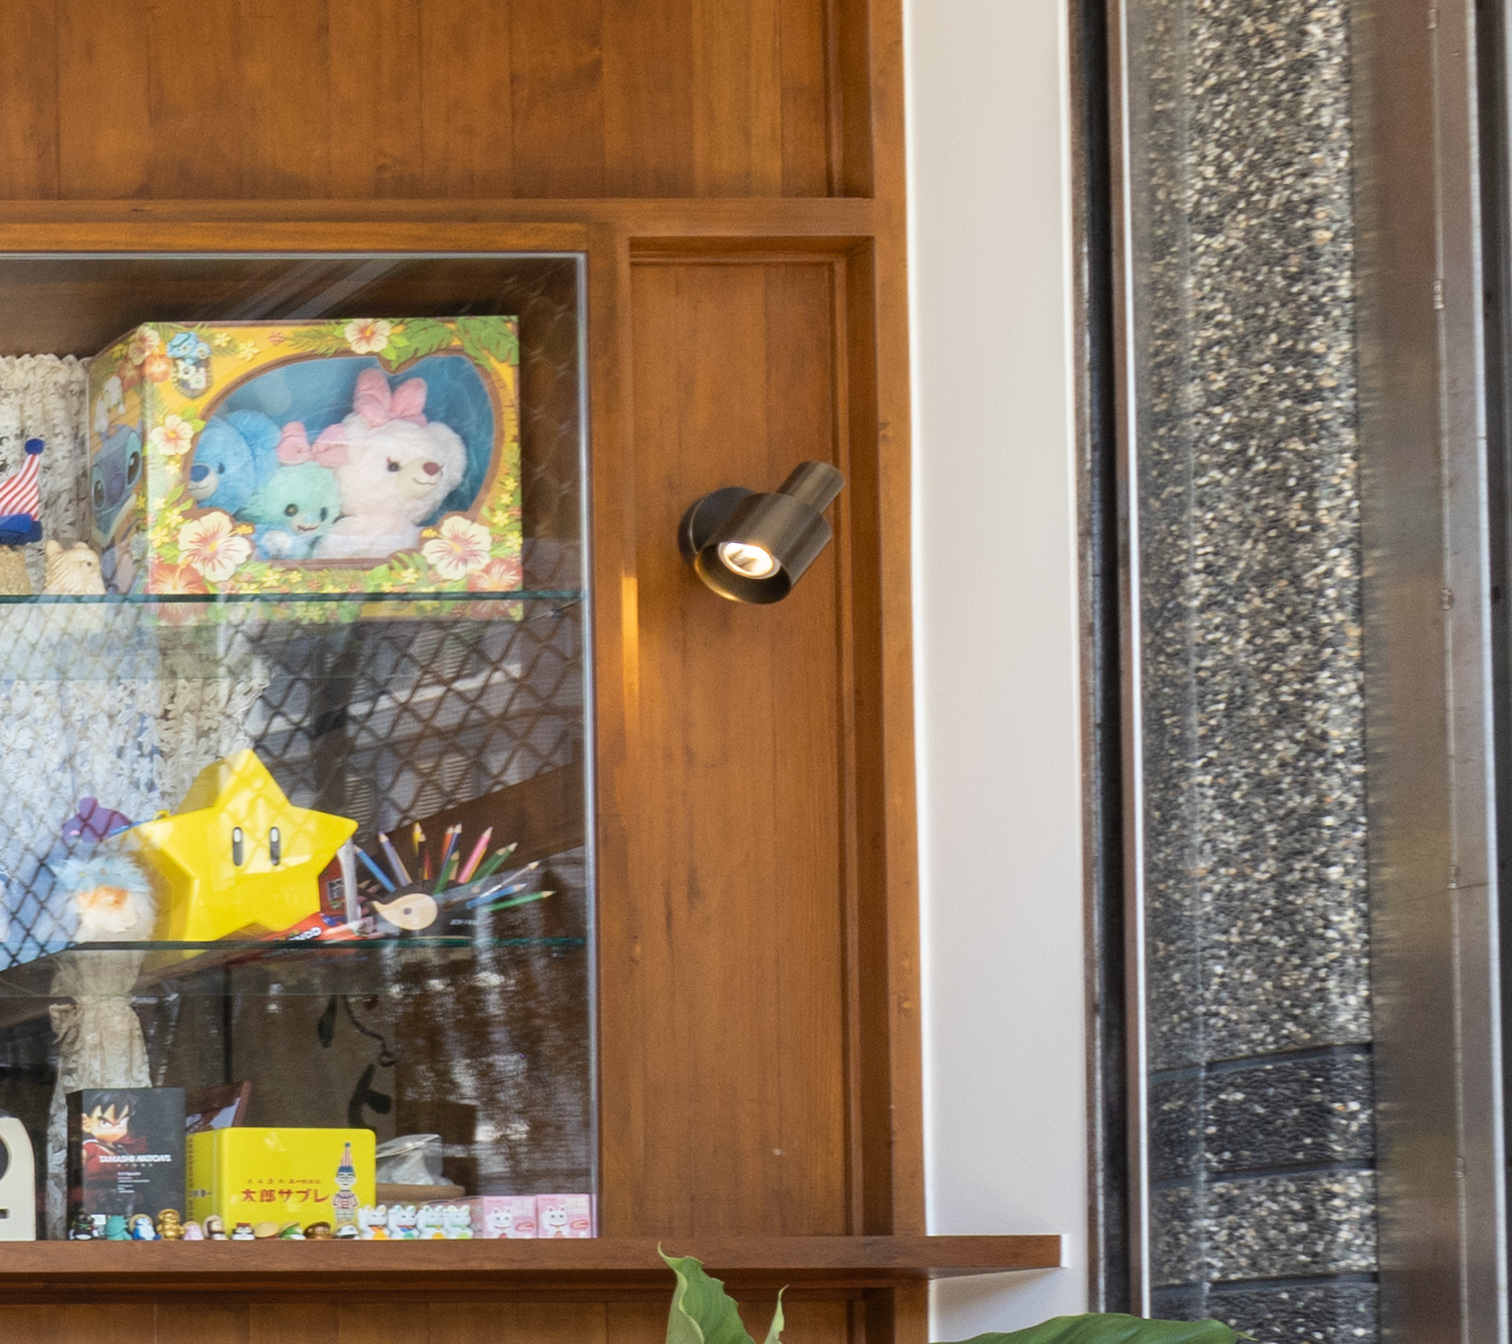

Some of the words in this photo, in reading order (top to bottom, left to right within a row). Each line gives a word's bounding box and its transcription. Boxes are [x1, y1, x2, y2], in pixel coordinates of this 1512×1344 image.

[241, 1187, 330, 1204] 太郎サブレ
